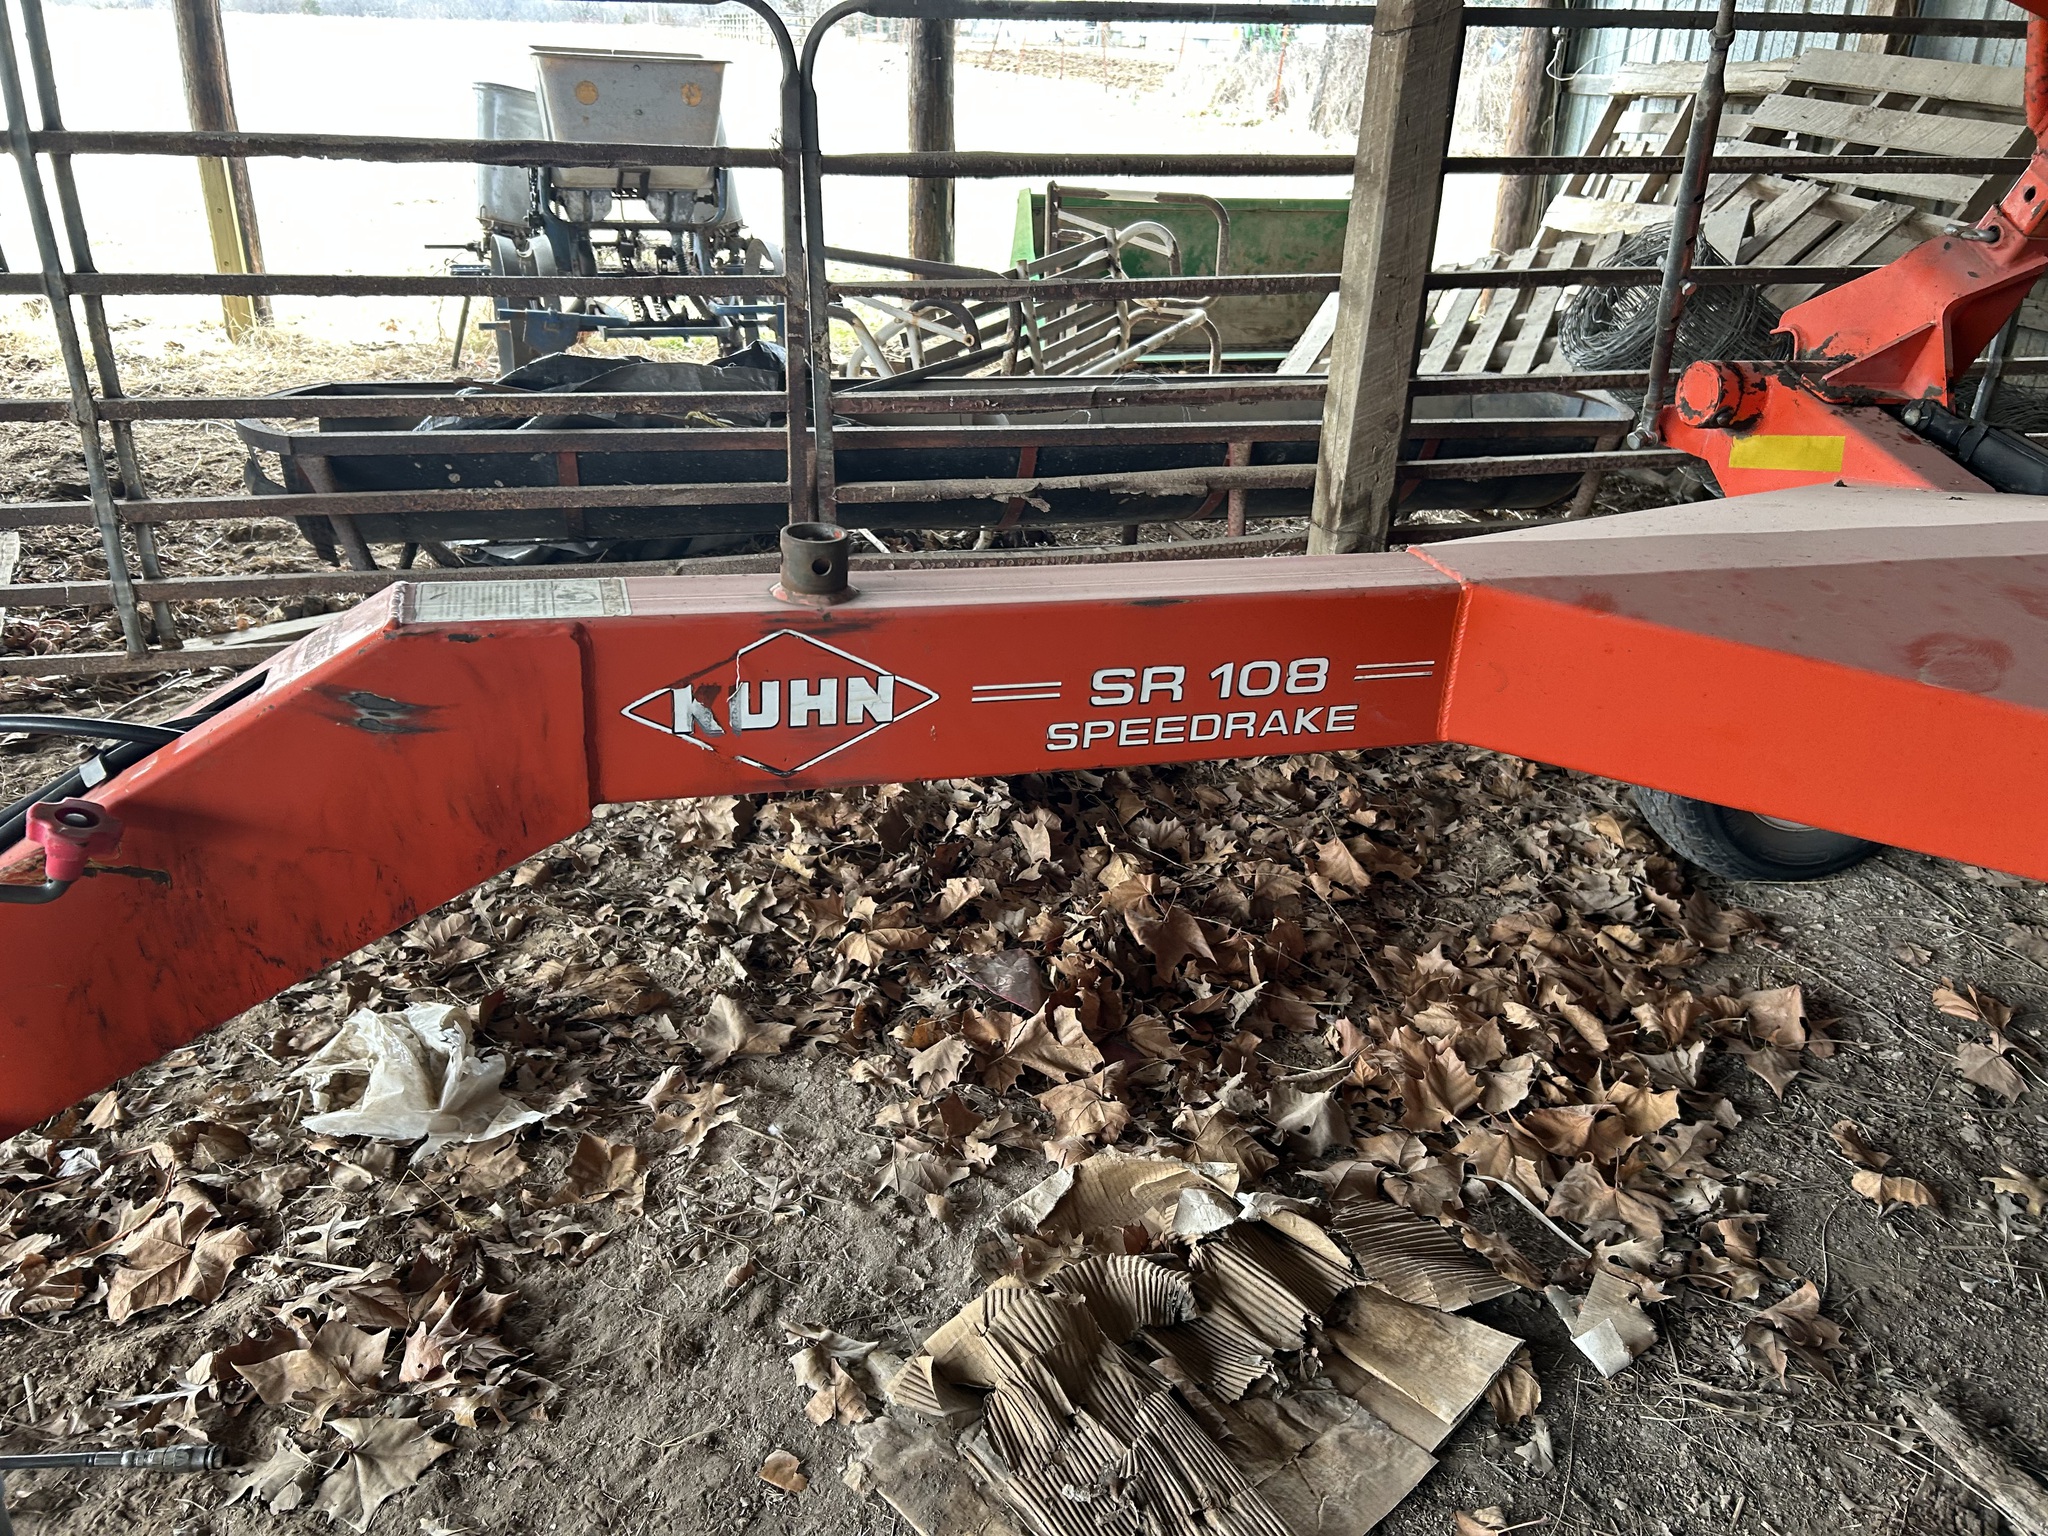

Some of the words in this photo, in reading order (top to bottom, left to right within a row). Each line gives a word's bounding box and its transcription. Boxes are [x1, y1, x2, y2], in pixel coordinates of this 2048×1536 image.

[671, 675, 895, 735] KUHN
[1090, 665, 1186, 706] SR
[1210, 657, 1330, 699] 108
[1046, 704, 1359, 751] SPEEDRAKE
